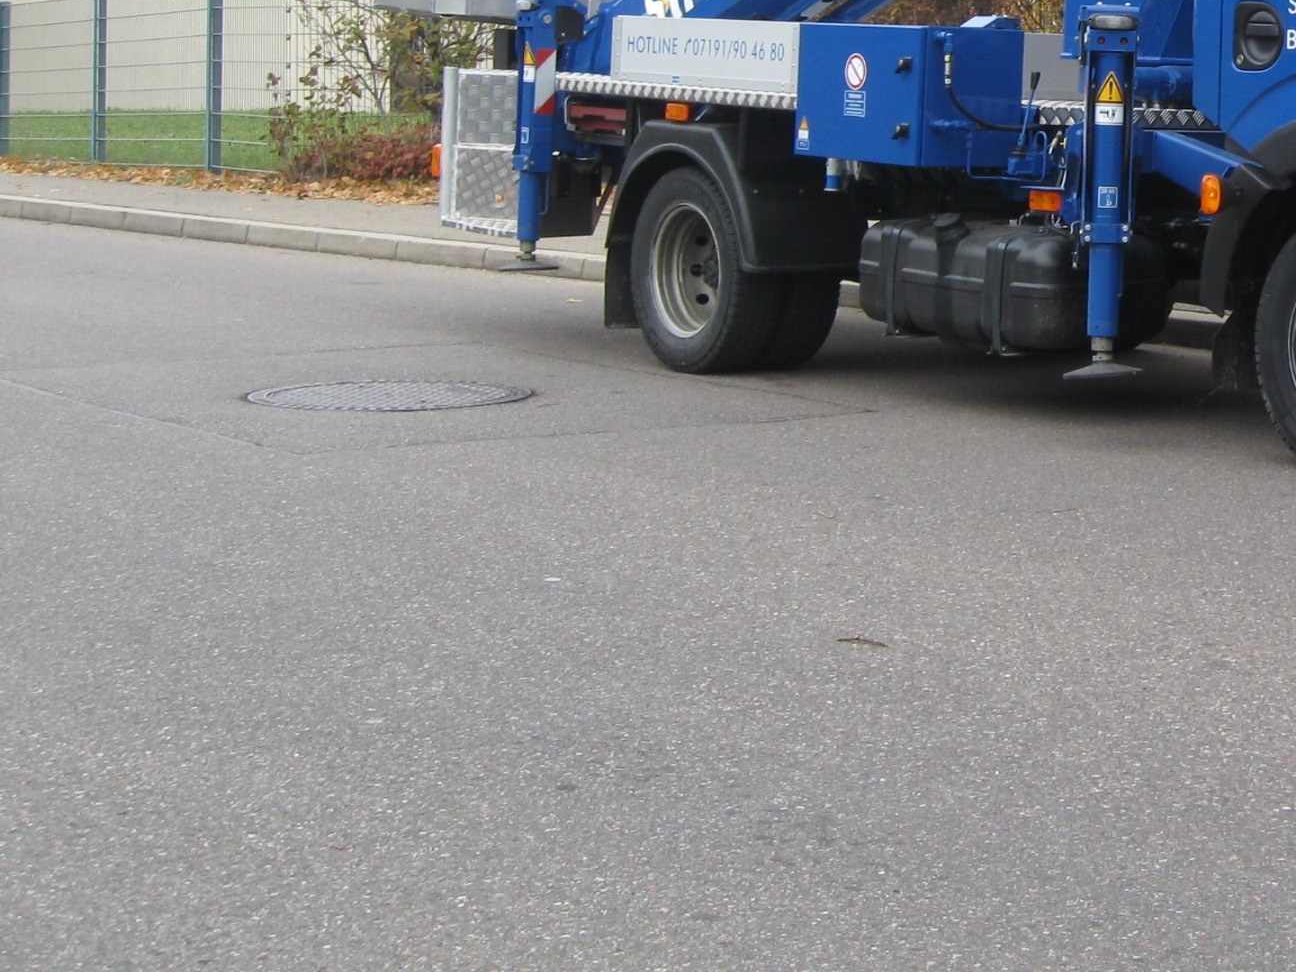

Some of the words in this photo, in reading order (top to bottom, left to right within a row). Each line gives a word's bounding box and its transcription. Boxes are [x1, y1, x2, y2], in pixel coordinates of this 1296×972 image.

[627, 36, 678, 55] HOTLINE
[692, 38, 747, 60] 07191/90
[751, 41, 766, 60] 46
[769, 42, 785, 62] 80
